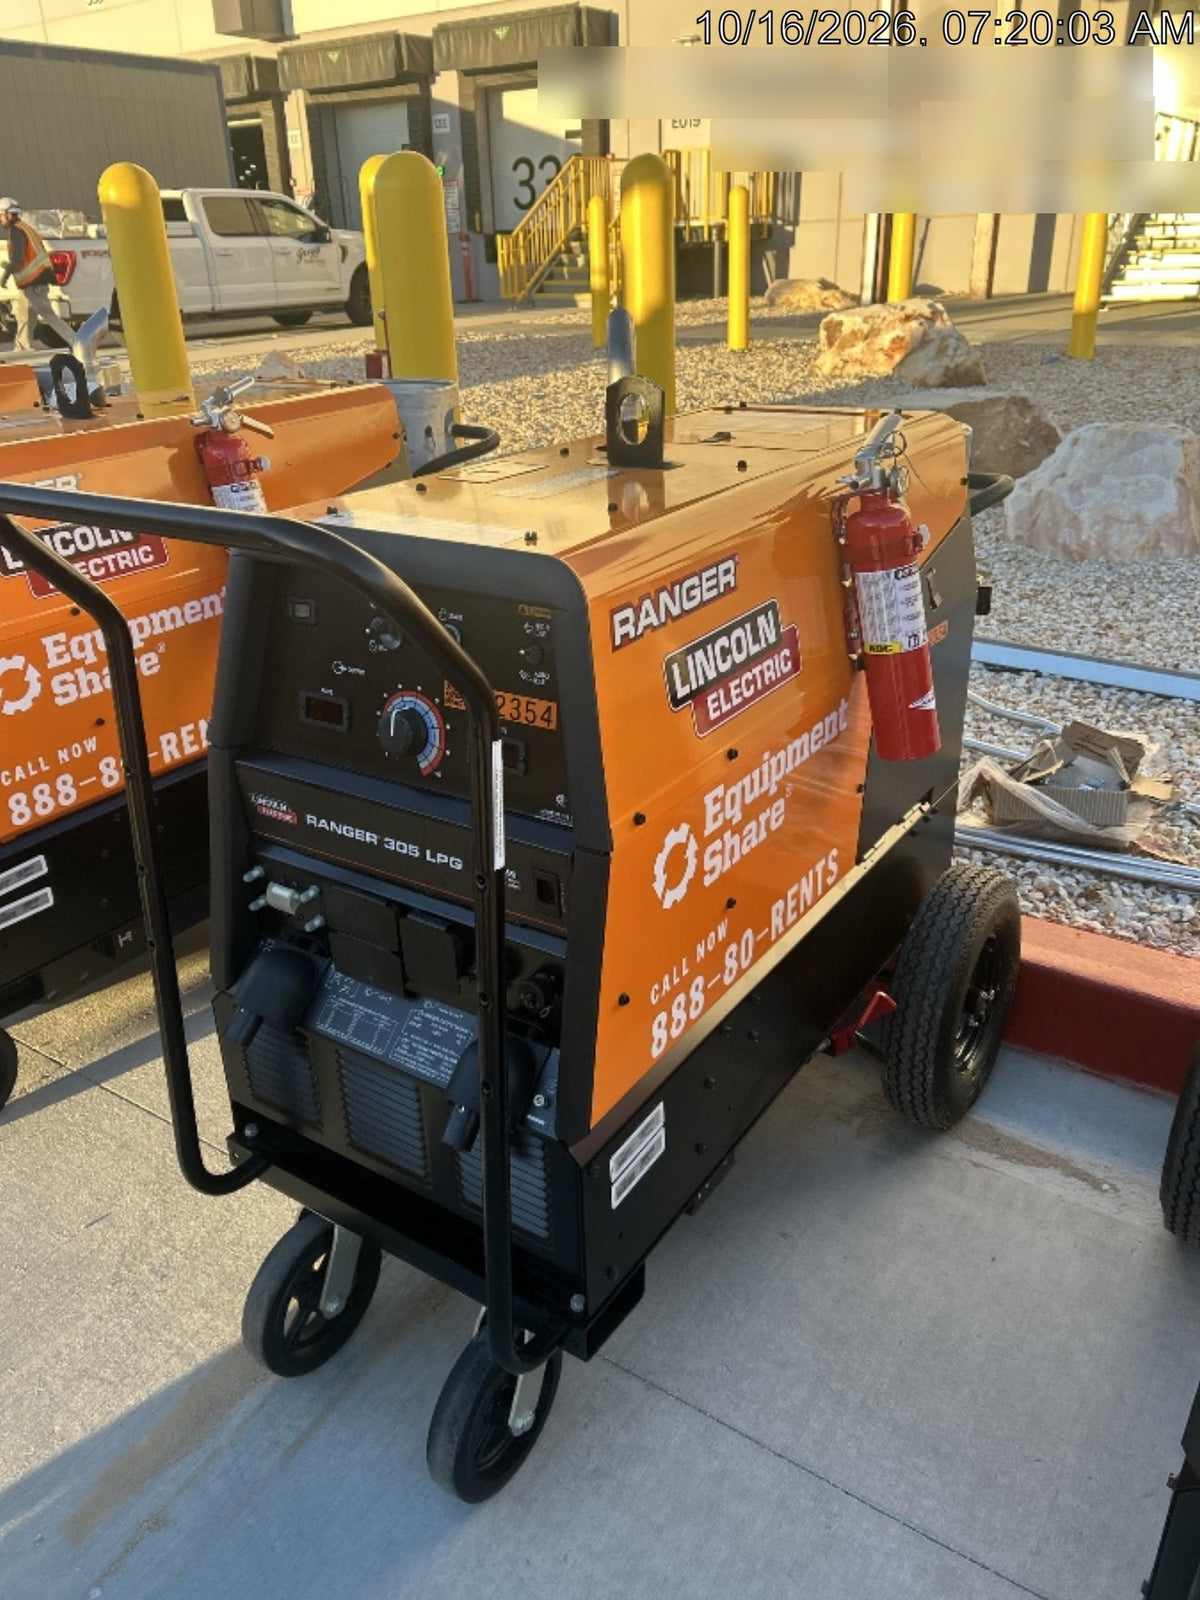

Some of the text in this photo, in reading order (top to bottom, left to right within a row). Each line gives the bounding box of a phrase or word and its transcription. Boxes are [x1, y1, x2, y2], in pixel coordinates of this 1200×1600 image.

[511, 153, 582, 211] 33
[611, 558, 738, 647] RANGER
[672, 610, 778, 699] LINCOLN
[706, 648, 793, 721] ELECTRIC
[1, 736, 97, 786] CALL NOW
[703, 698, 849, 838] Equipment
[305, 813, 464, 871] RANGER 305 LPG
[703, 797, 786, 887] Share
[650, 847, 840, 1059] 888-80-RENTS
[650, 918, 729, 1005] CALL NOW
